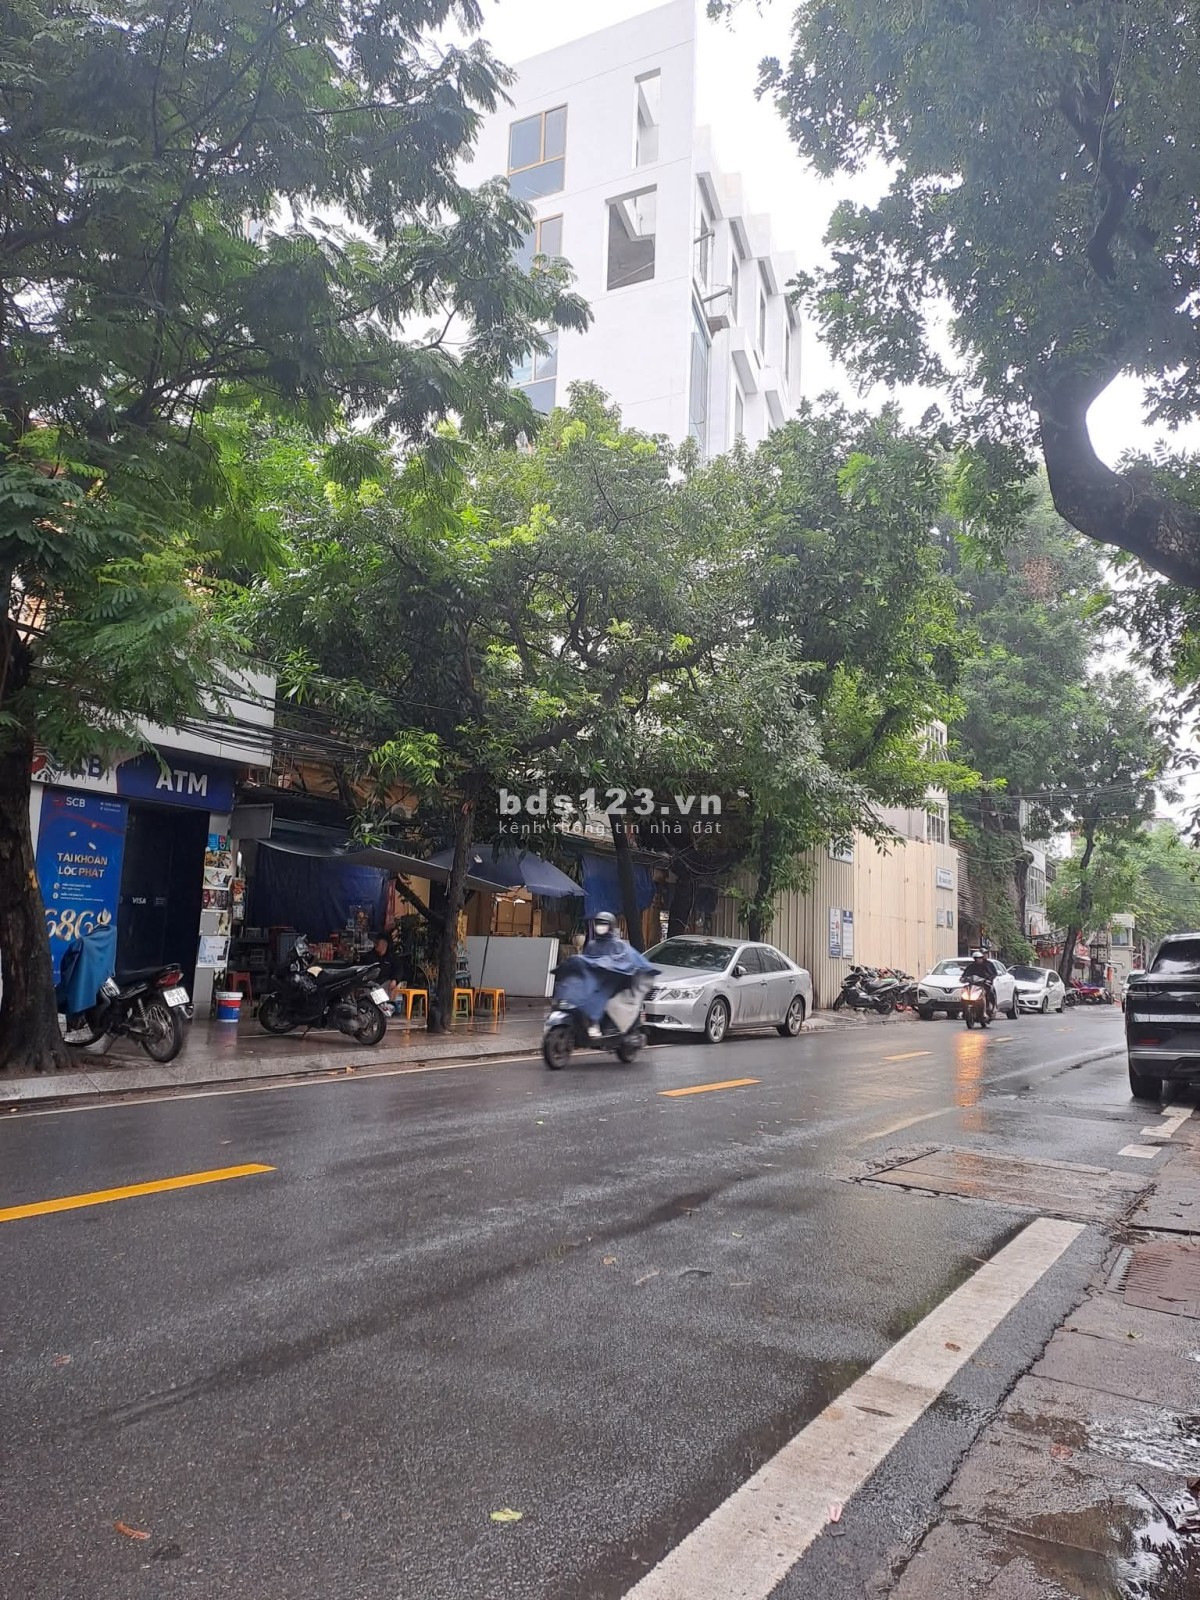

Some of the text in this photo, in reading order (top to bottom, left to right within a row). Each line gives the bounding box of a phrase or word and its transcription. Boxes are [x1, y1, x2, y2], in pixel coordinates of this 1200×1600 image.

[155, 769, 208, 797] ATM
[65, 796, 86, 808] SCB
[132, 896, 147, 905] VISA
